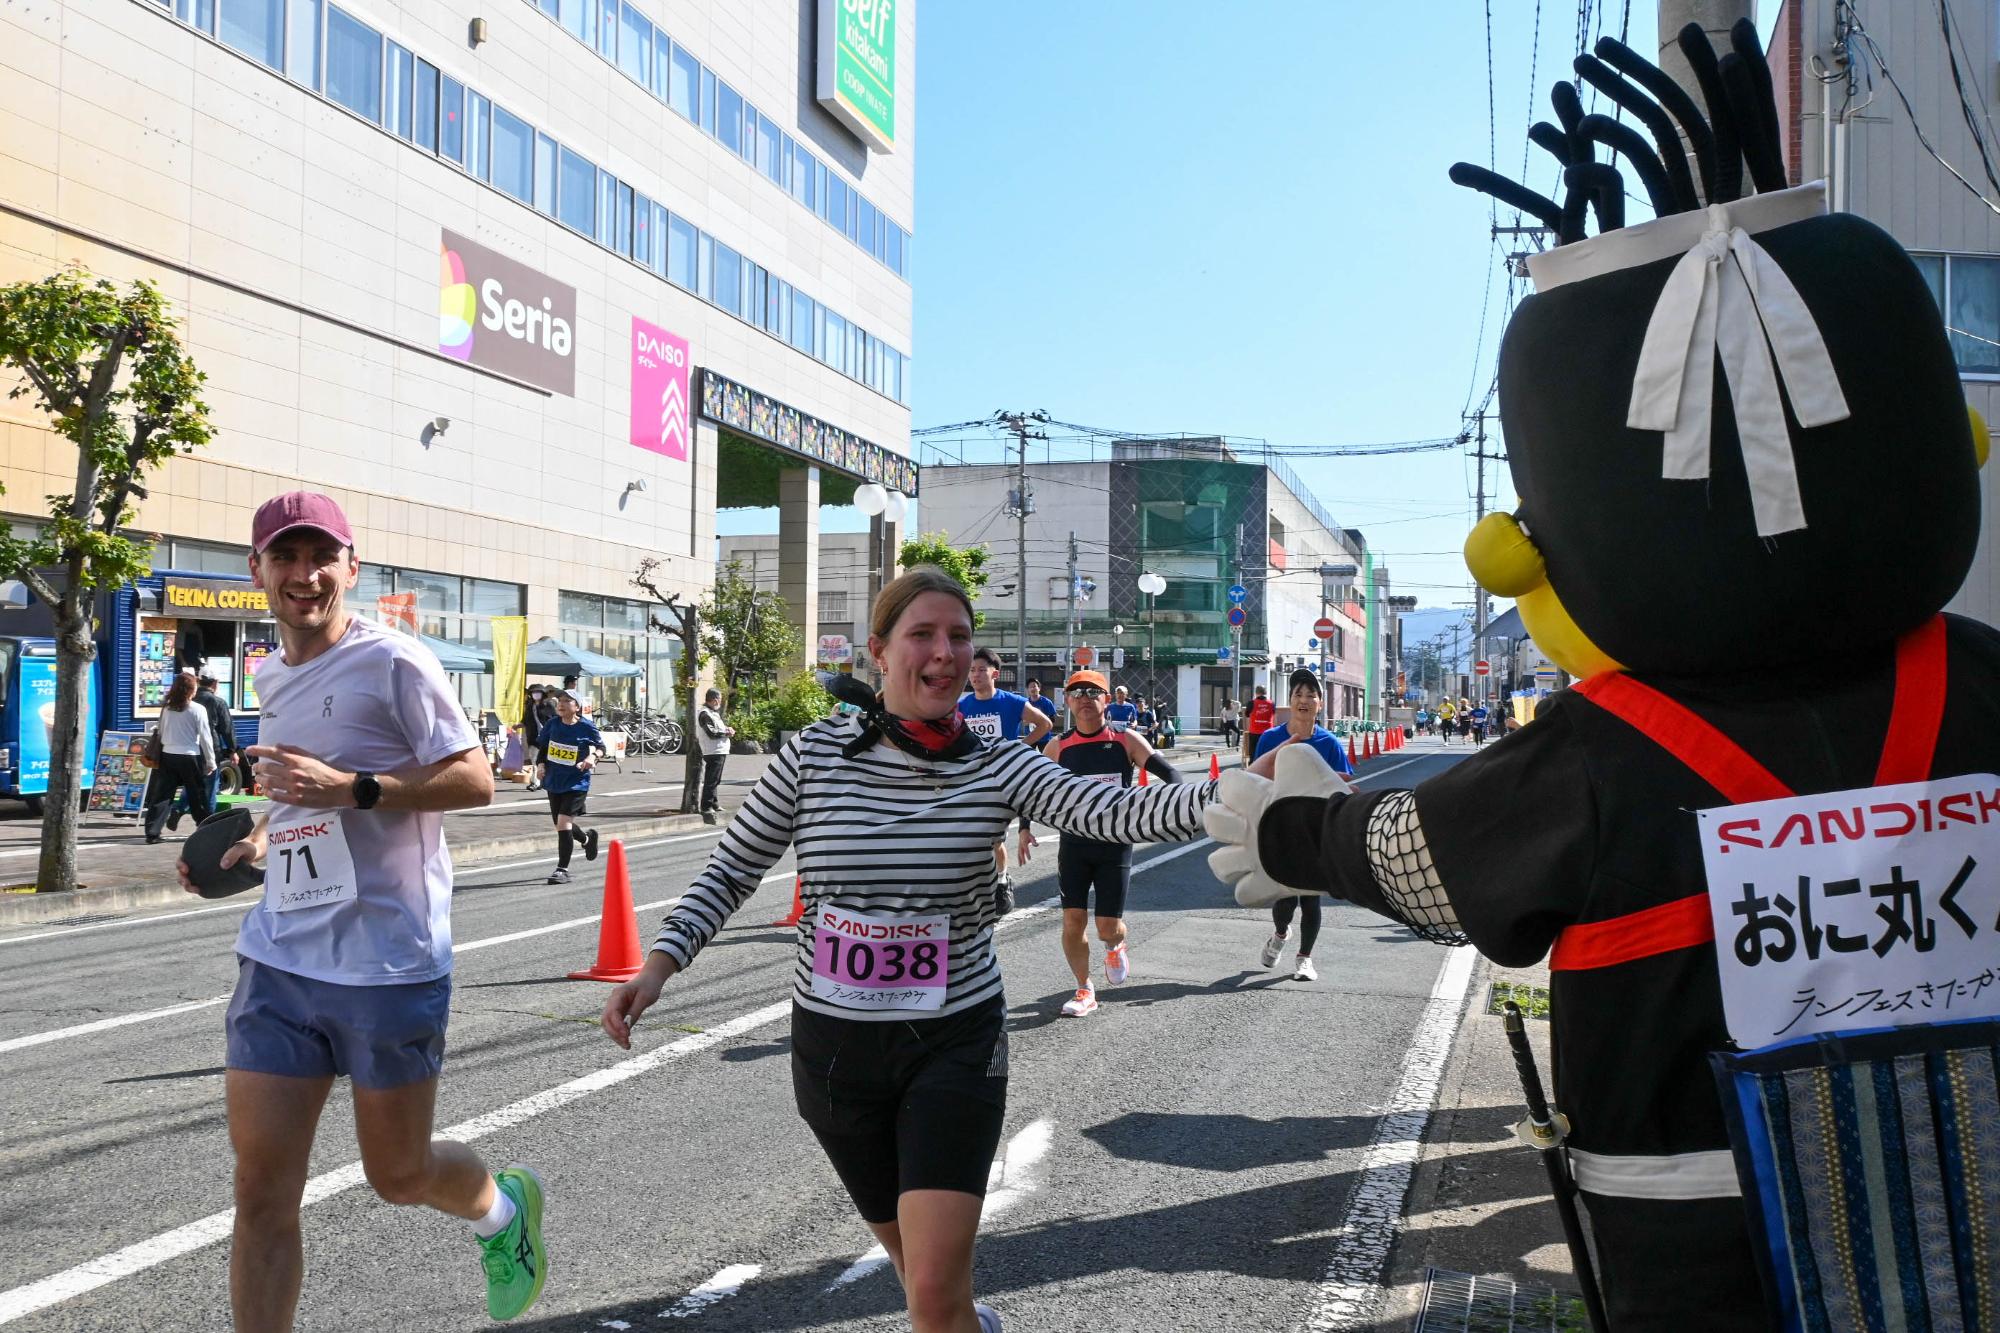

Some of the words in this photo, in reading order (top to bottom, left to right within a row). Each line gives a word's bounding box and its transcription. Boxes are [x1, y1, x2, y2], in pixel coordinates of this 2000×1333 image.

[481, 278, 572, 356] Seria
[637, 330, 684, 368] DAISO
[166, 584, 217, 609] TEKINA
[218, 589, 270, 610] COFFEE
[549, 746, 575, 760] 3425
[1717, 787, 2000, 853] SANDISK
[279, 844, 318, 884] 71
[1731, 855, 2000, 967] おに丸く
[825, 935, 939, 982] 1038
[1773, 968, 2000, 1036] ランフェスきたか
